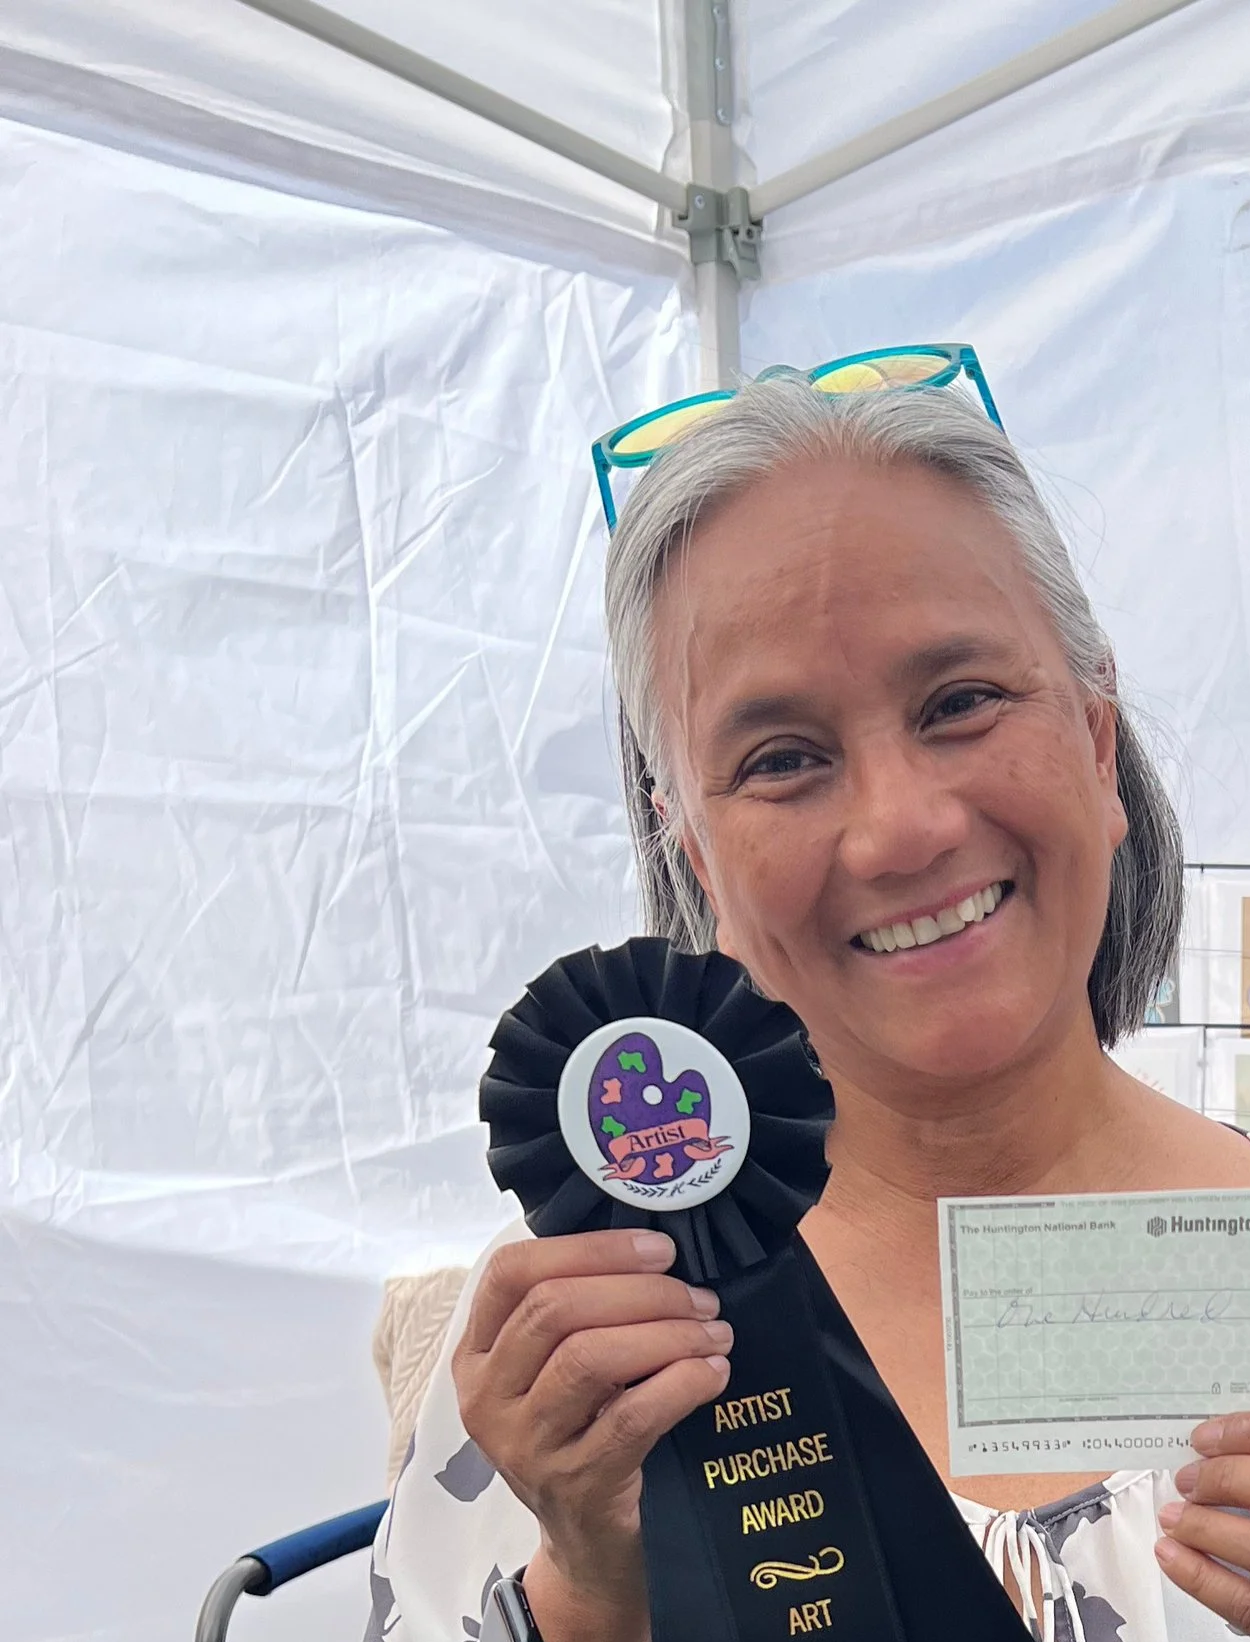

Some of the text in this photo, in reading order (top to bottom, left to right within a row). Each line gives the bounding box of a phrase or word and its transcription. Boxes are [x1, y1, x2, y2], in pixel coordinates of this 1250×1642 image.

[626, 1125, 686, 1151] Artist
[960, 1220, 1116, 1236] The Huntington National Bank
[714, 1388, 793, 1433] ARTIST
[703, 1432, 833, 1489] PURCHASE
[742, 1490, 825, 1535] AWARD
[789, 1598, 833, 1636] ART
